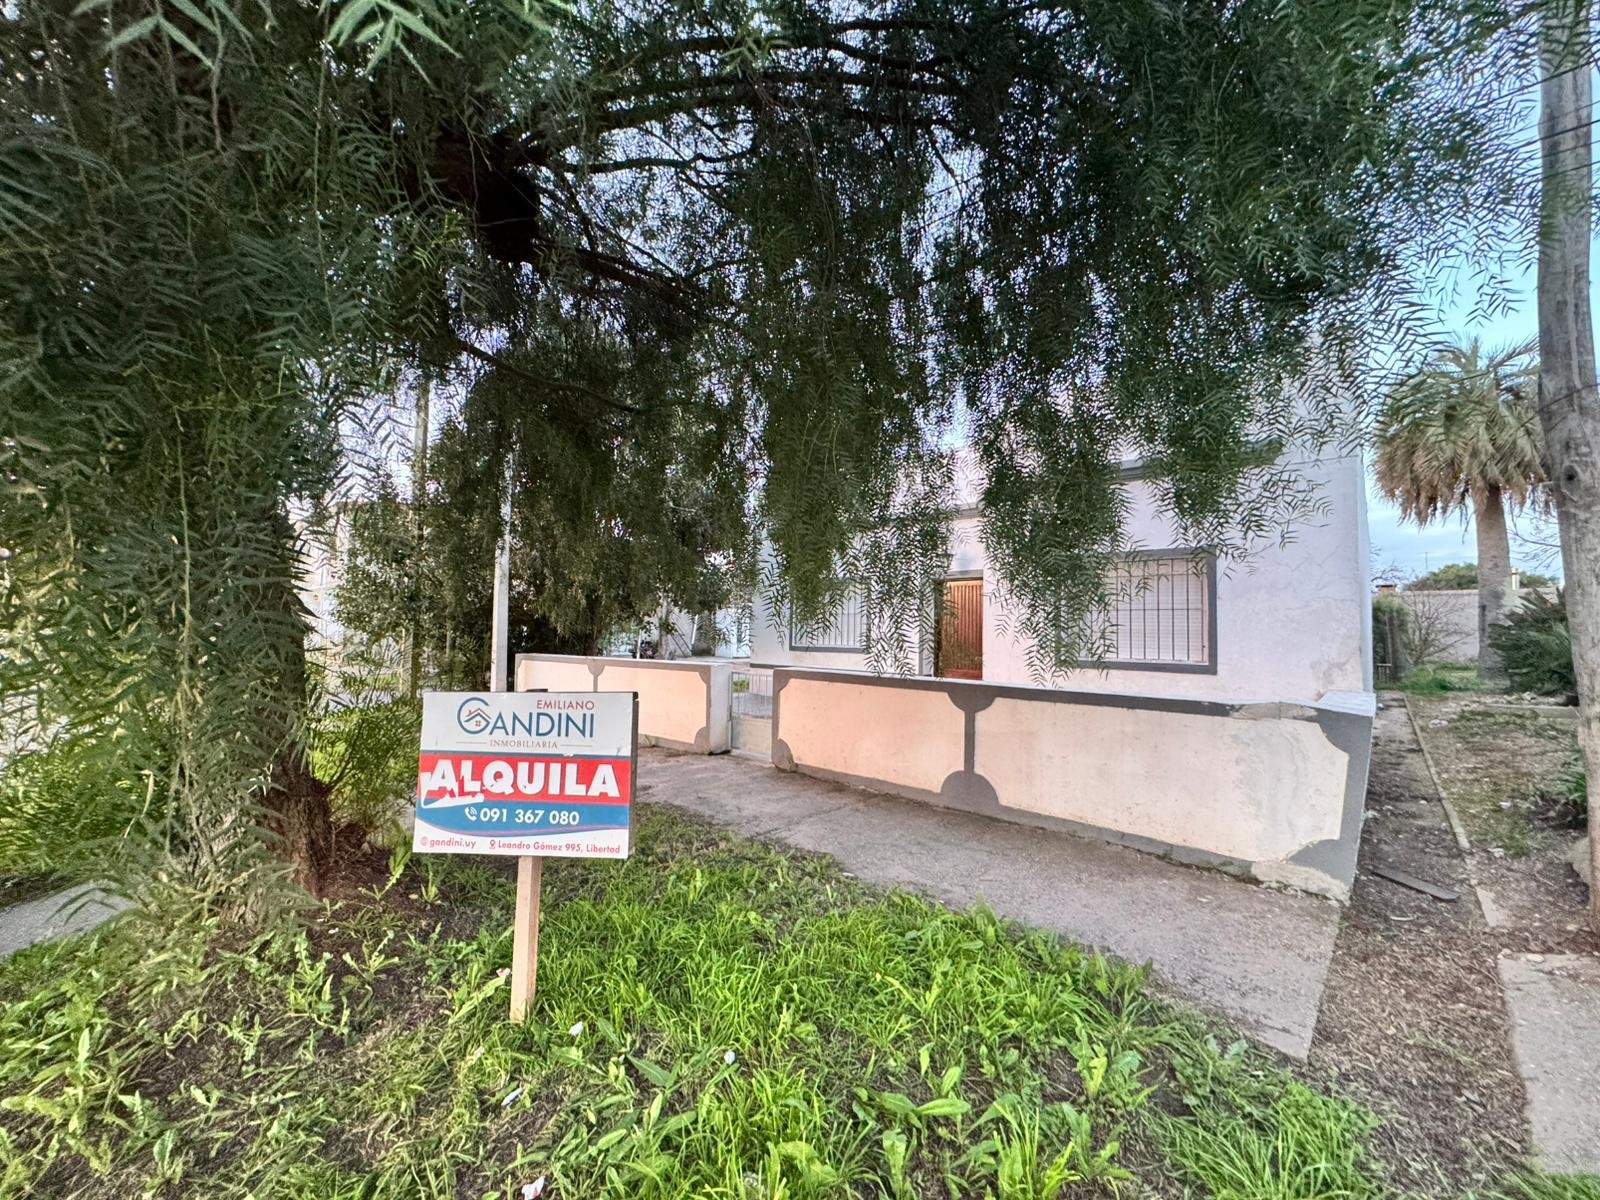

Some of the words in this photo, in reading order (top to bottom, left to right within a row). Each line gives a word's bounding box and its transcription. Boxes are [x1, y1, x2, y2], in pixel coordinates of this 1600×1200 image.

[536, 700, 595, 711] EMILIANO
[489, 739, 558, 749] INMOBILIARIA
[427, 759, 620, 798] ALQUILA
[480, 807, 507, 822] 091
[514, 809, 544, 824] 367
[549, 811, 580, 825] 080
[429, 837, 476, 850] gandini.uy
[498, 840, 530, 850] Leandro
[533, 841, 563, 851] Gómez
[565, 843, 584, 853] 995,
[586, 844, 620, 854] Libertad
